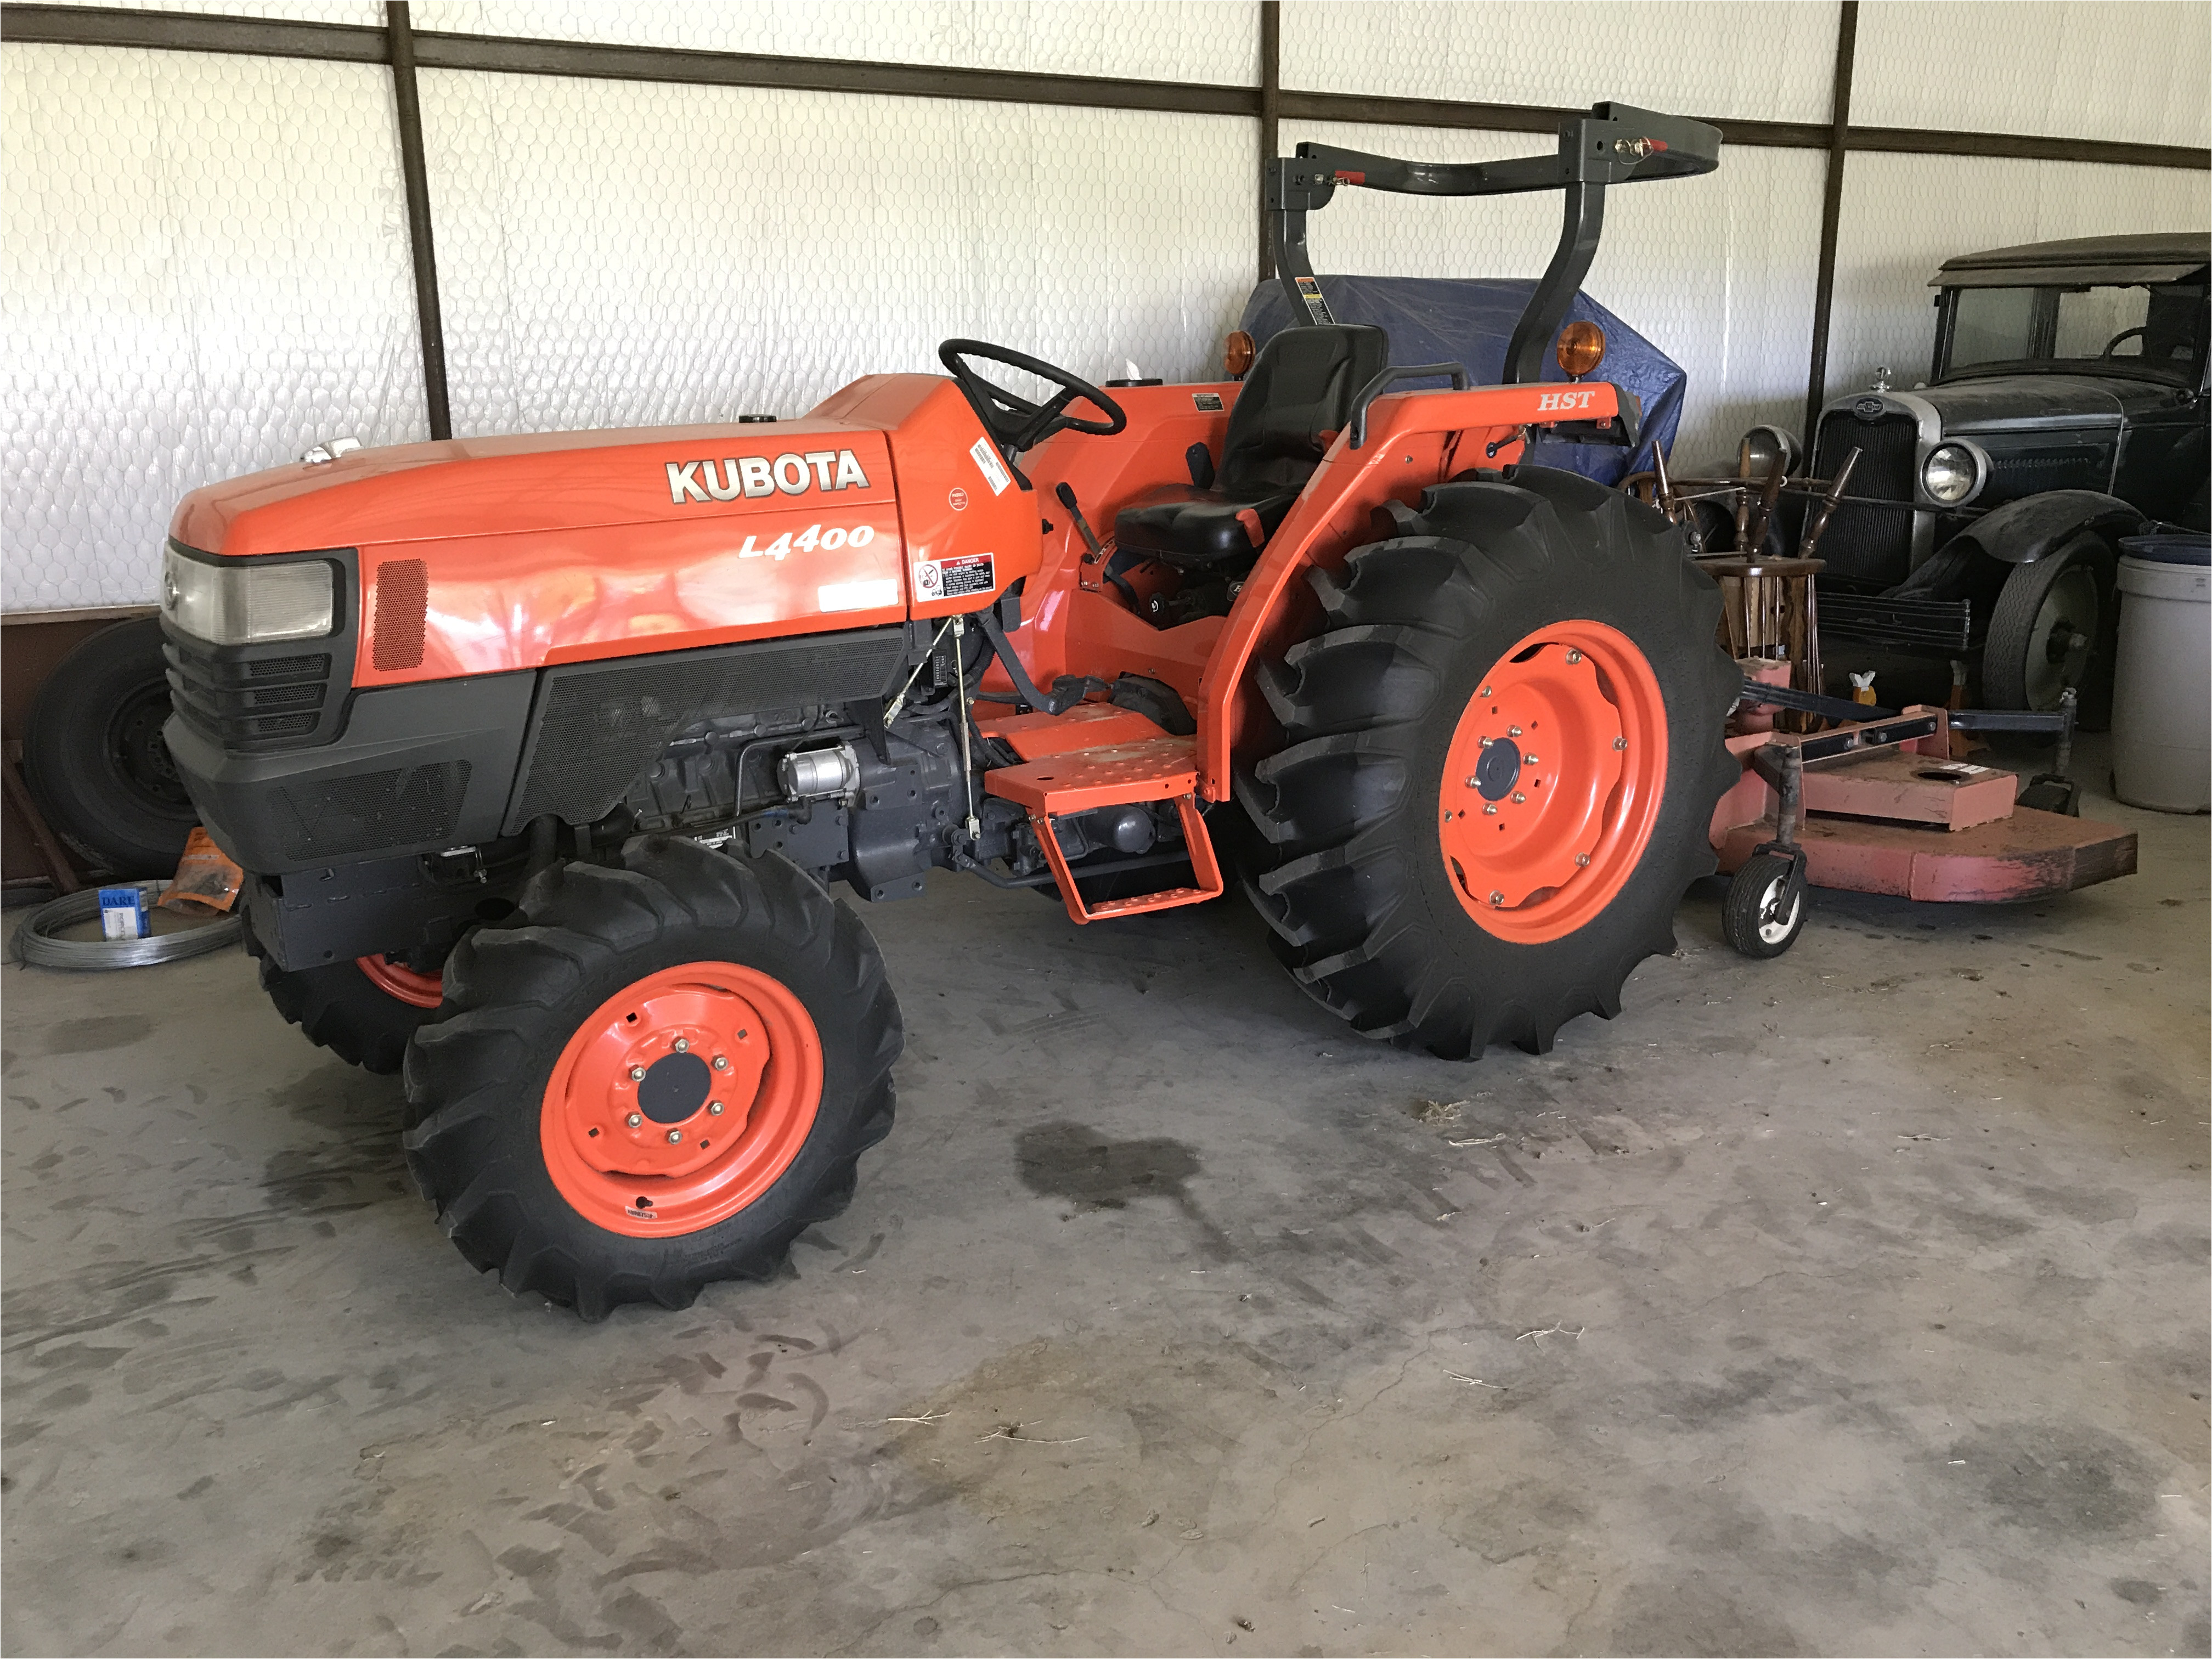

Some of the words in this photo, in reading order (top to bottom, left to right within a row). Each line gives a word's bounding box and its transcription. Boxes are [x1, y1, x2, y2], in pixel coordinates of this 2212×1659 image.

[1537, 391, 1595, 411] HST
[665, 449, 870, 504] KUBOTA
[738, 524, 874, 561] L4400
[102, 896, 135, 906] DARE
